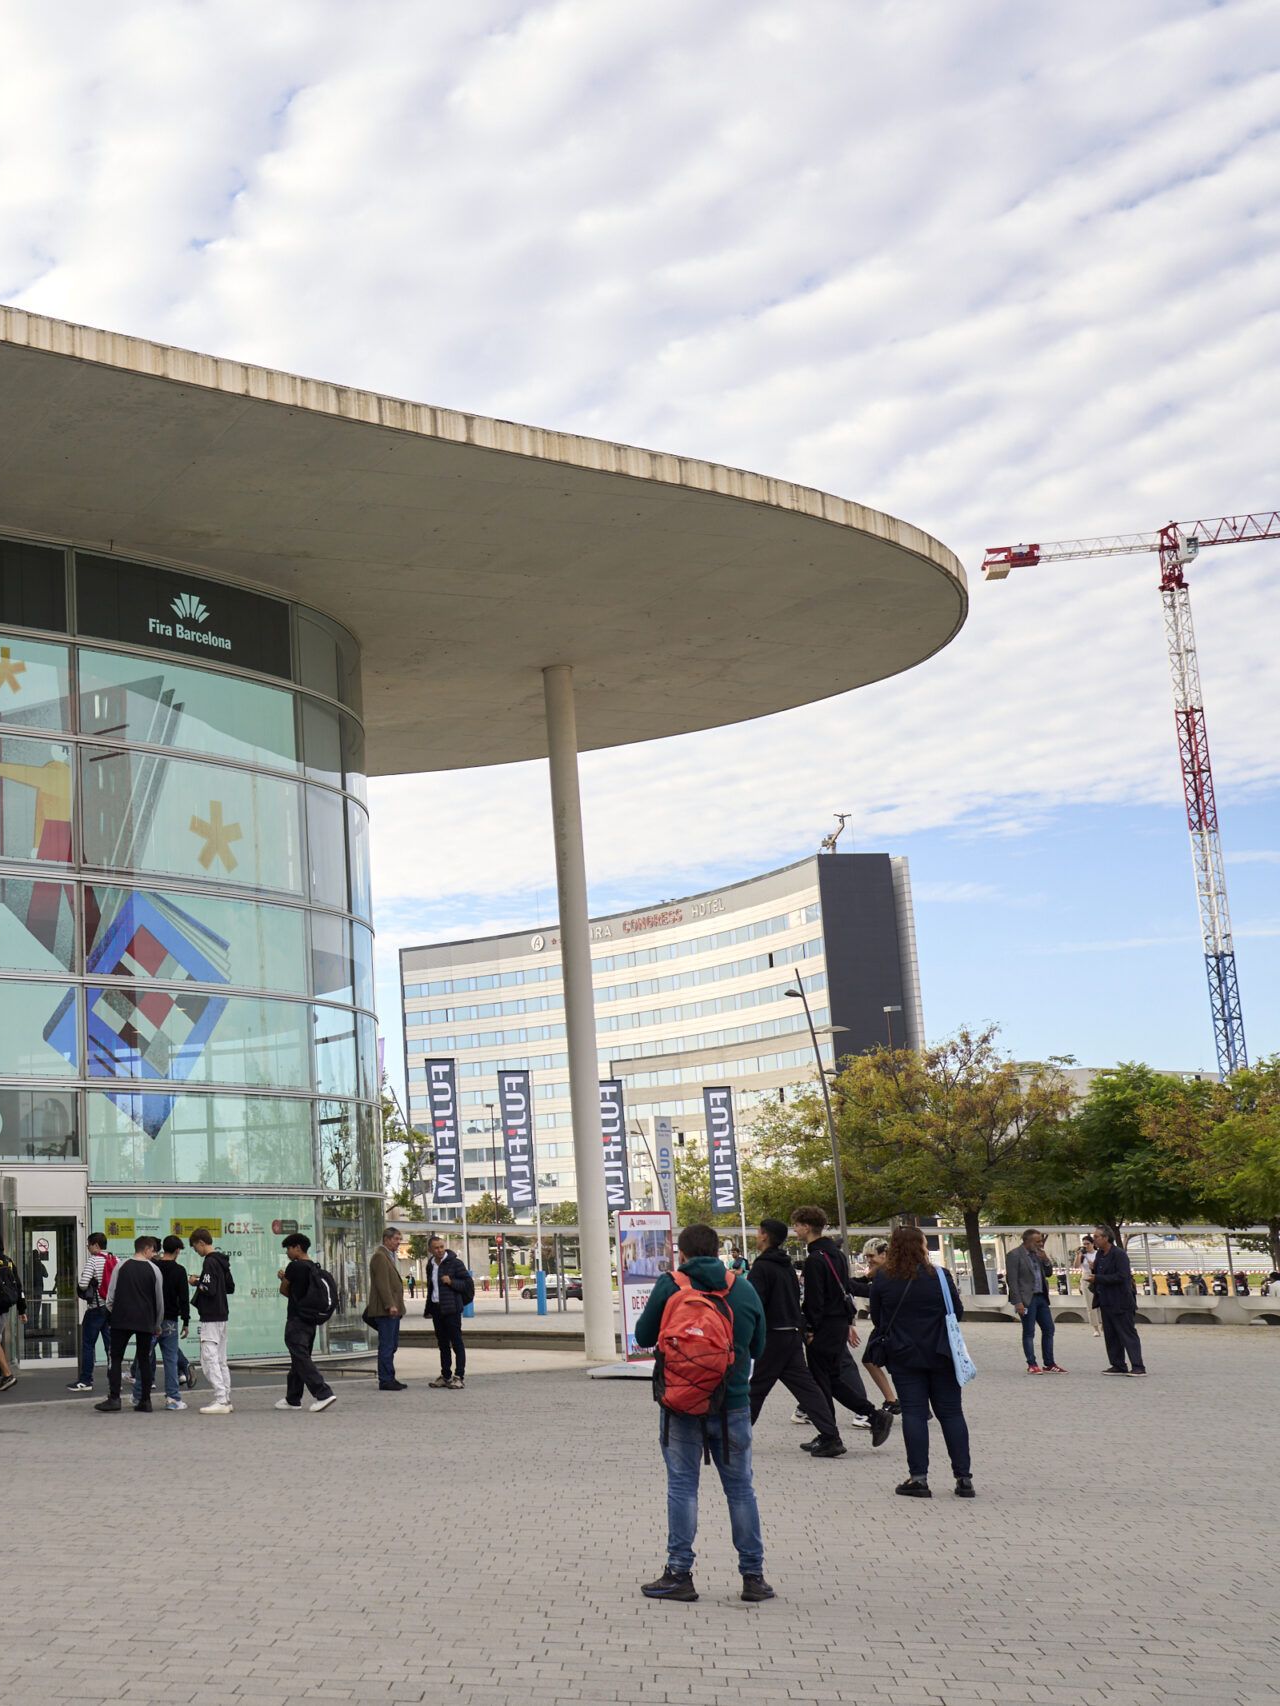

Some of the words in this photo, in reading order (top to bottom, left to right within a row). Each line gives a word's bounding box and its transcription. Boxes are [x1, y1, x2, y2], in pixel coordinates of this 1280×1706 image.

[148, 617, 172, 637] Fira
[175, 623, 232, 650] Barcelona
[590, 926, 612, 940] IRA
[622, 908, 683, 934] CONGRESS
[692, 898, 726, 918] HOTEL
